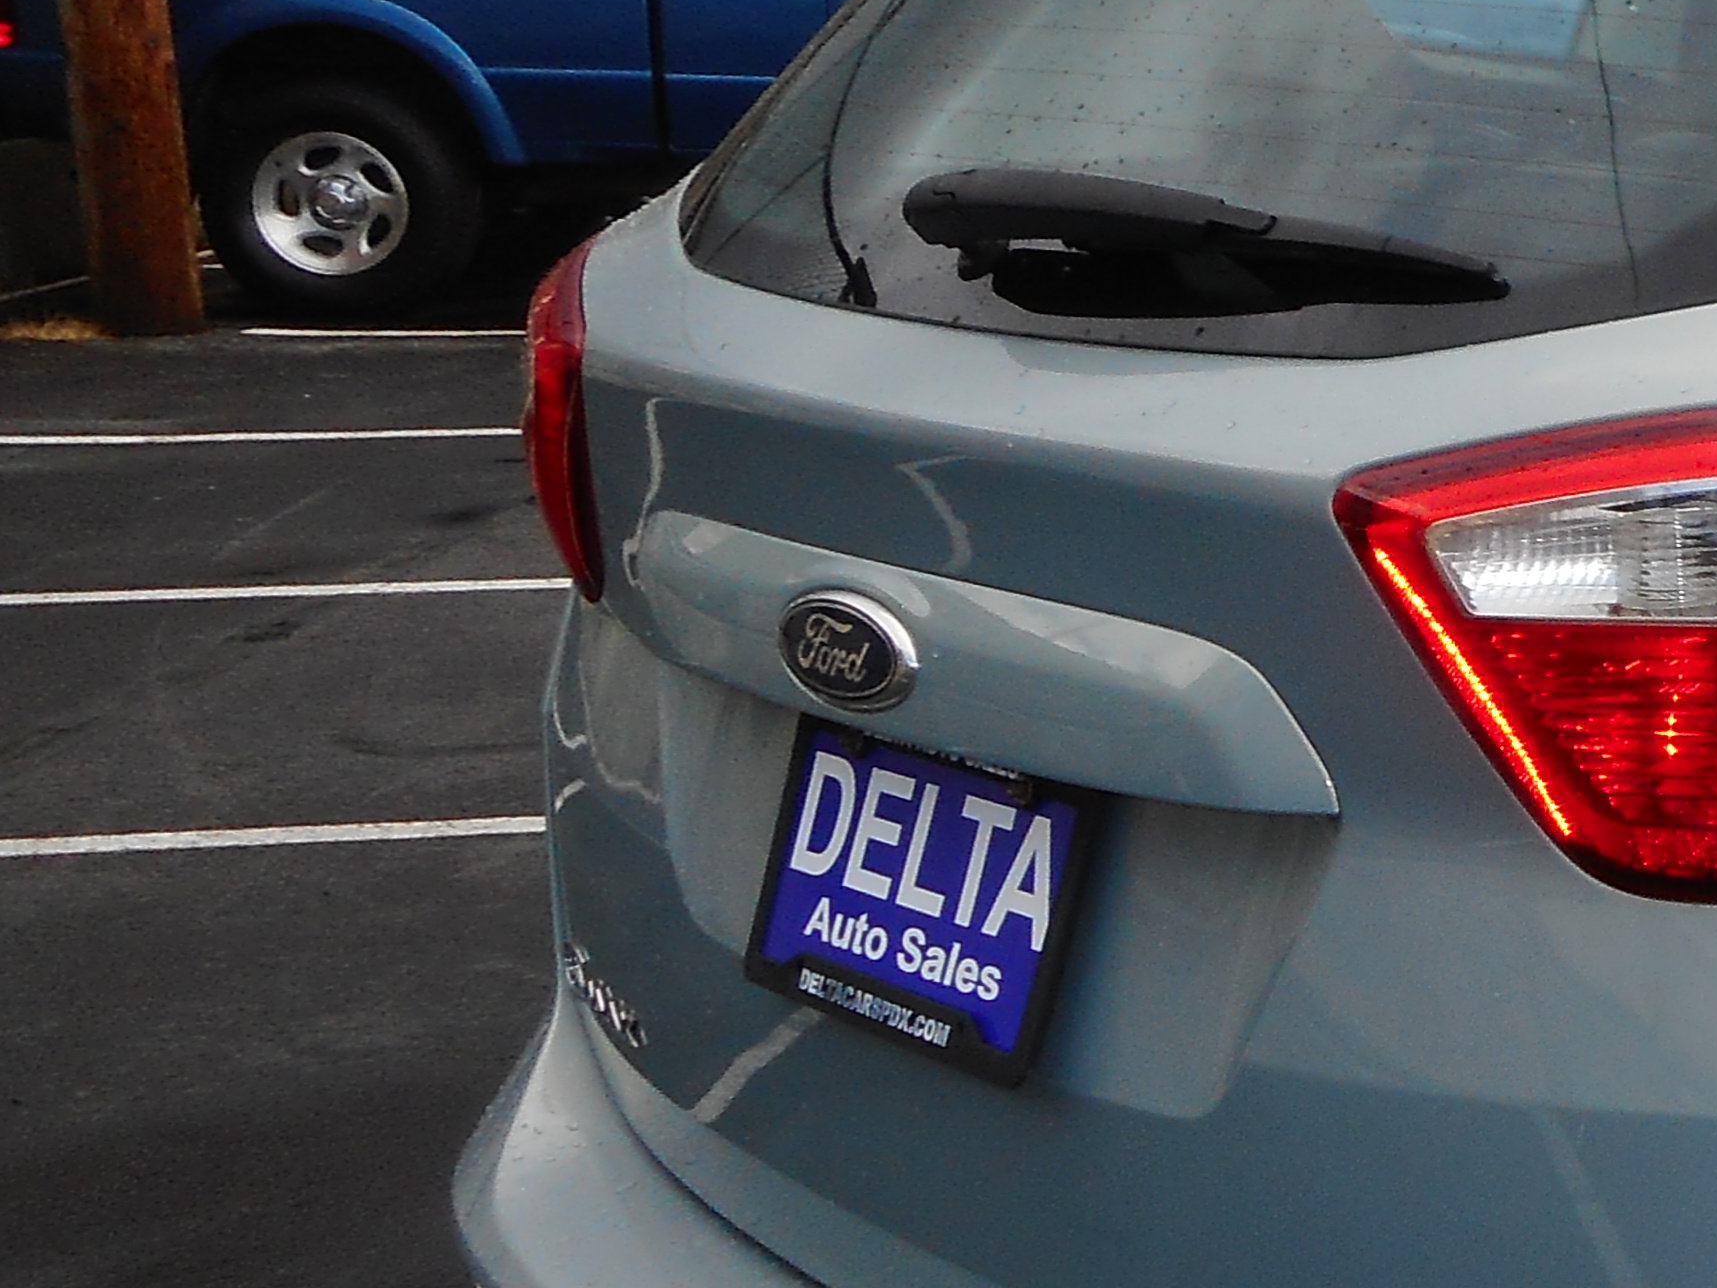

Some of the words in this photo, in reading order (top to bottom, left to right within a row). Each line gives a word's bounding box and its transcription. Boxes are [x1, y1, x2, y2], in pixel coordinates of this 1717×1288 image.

[797, 612, 870, 683] Ford
[788, 750, 1053, 953] DELTA
[803, 896, 889, 961] Auto
[896, 927, 1003, 1001] Sales
[798, 967, 952, 1048] DELTACARSPDX.COM
